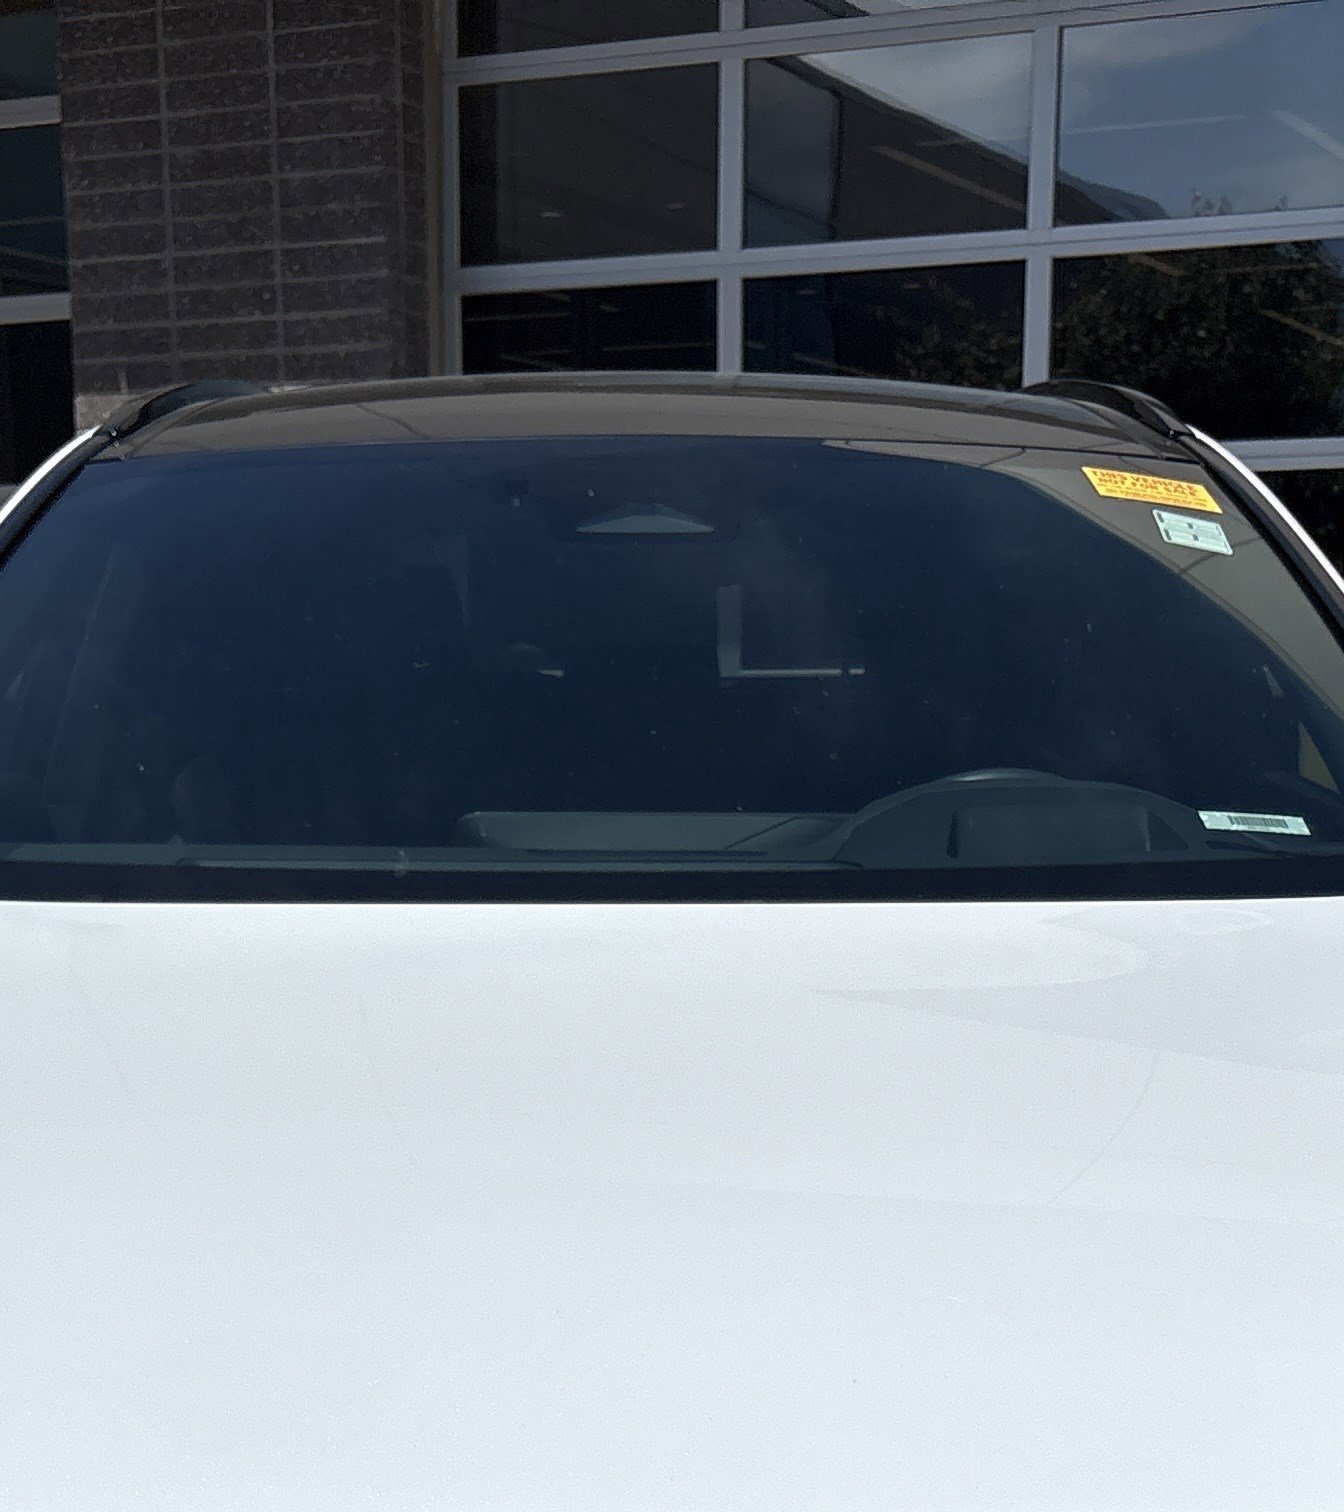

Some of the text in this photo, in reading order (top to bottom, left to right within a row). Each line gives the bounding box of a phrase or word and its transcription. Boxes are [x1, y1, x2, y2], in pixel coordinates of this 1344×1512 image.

[1091, 470, 1198, 492] THIS VEHICLE
[1097, 477, 1126, 486] NOT
